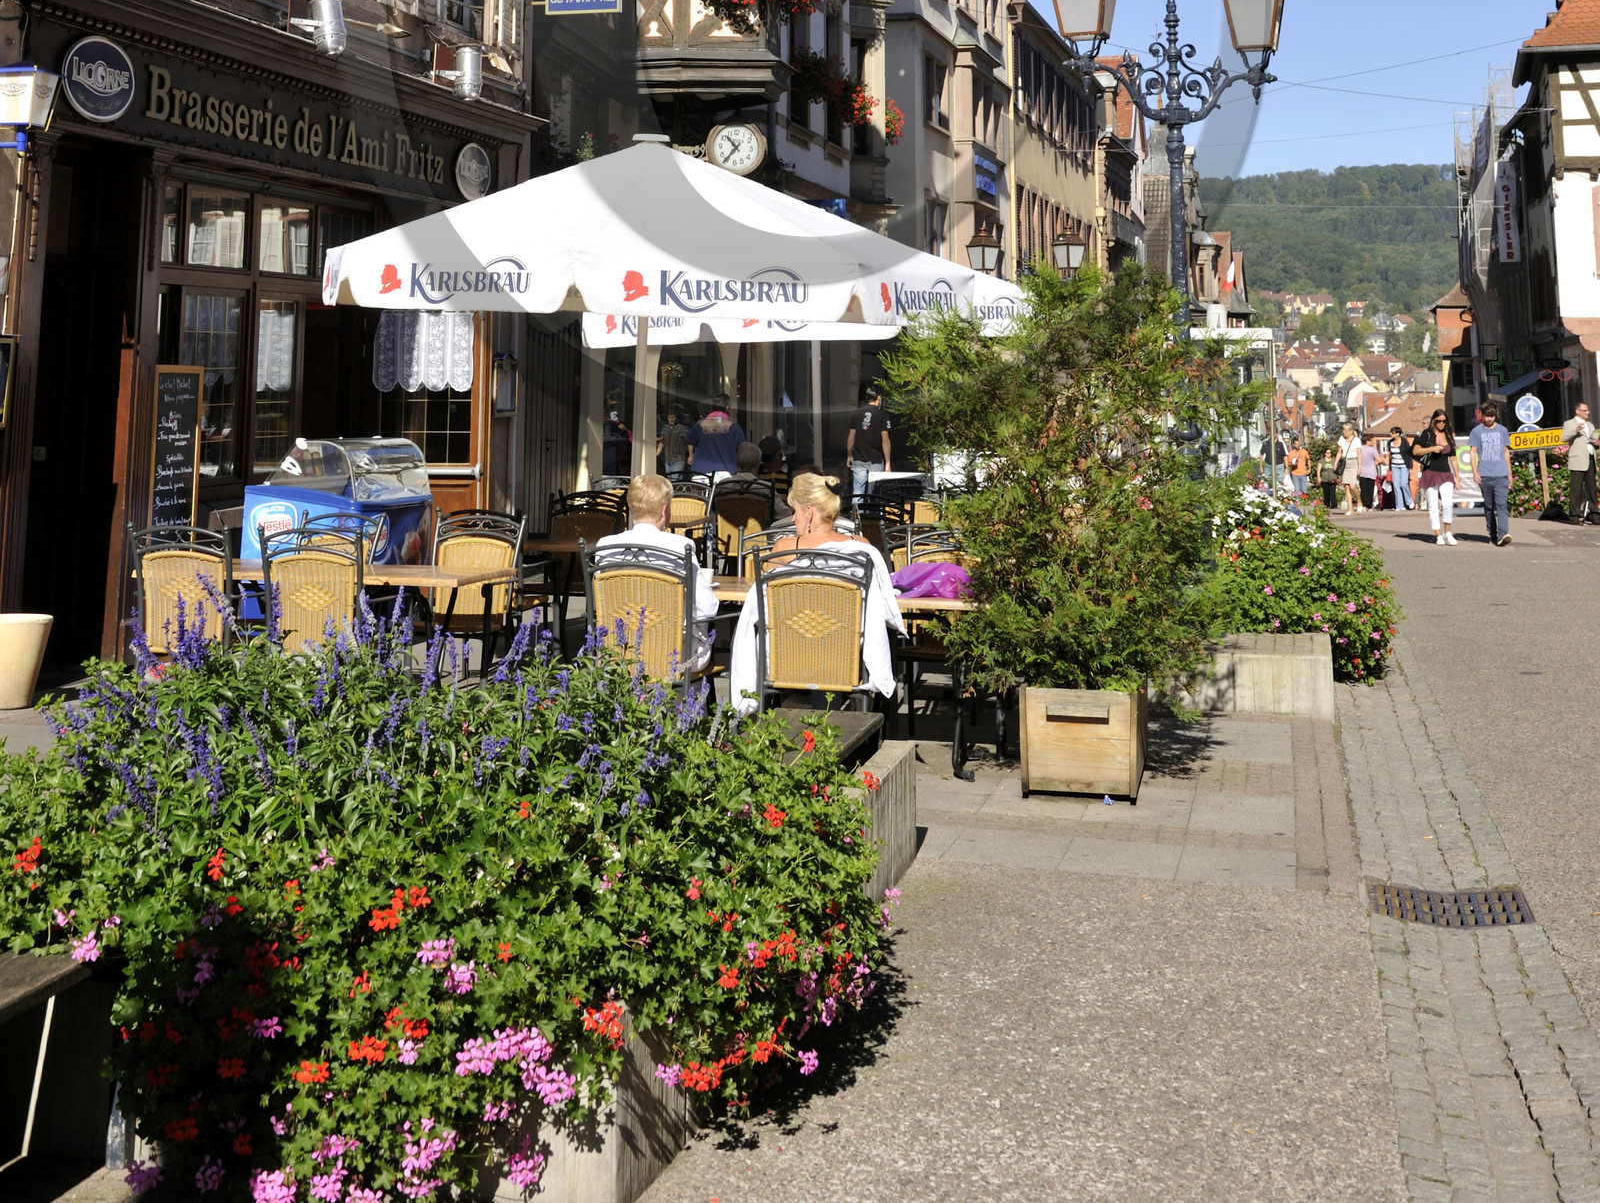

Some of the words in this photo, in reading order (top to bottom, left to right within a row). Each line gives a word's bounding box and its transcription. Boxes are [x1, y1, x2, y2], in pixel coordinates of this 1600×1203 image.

[72, 56, 130, 96] LICORNE
[145, 64, 288, 149] Brasserie
[294, 107, 322, 157] de
[327, 115, 389, 173] l'Ami
[395, 133, 444, 184] Fritz
[410, 259, 532, 304] KARLSBRÄU
[660, 268, 809, 313] KARLSBRÄU
[1514, 432, 1560, 447] Déviatio
